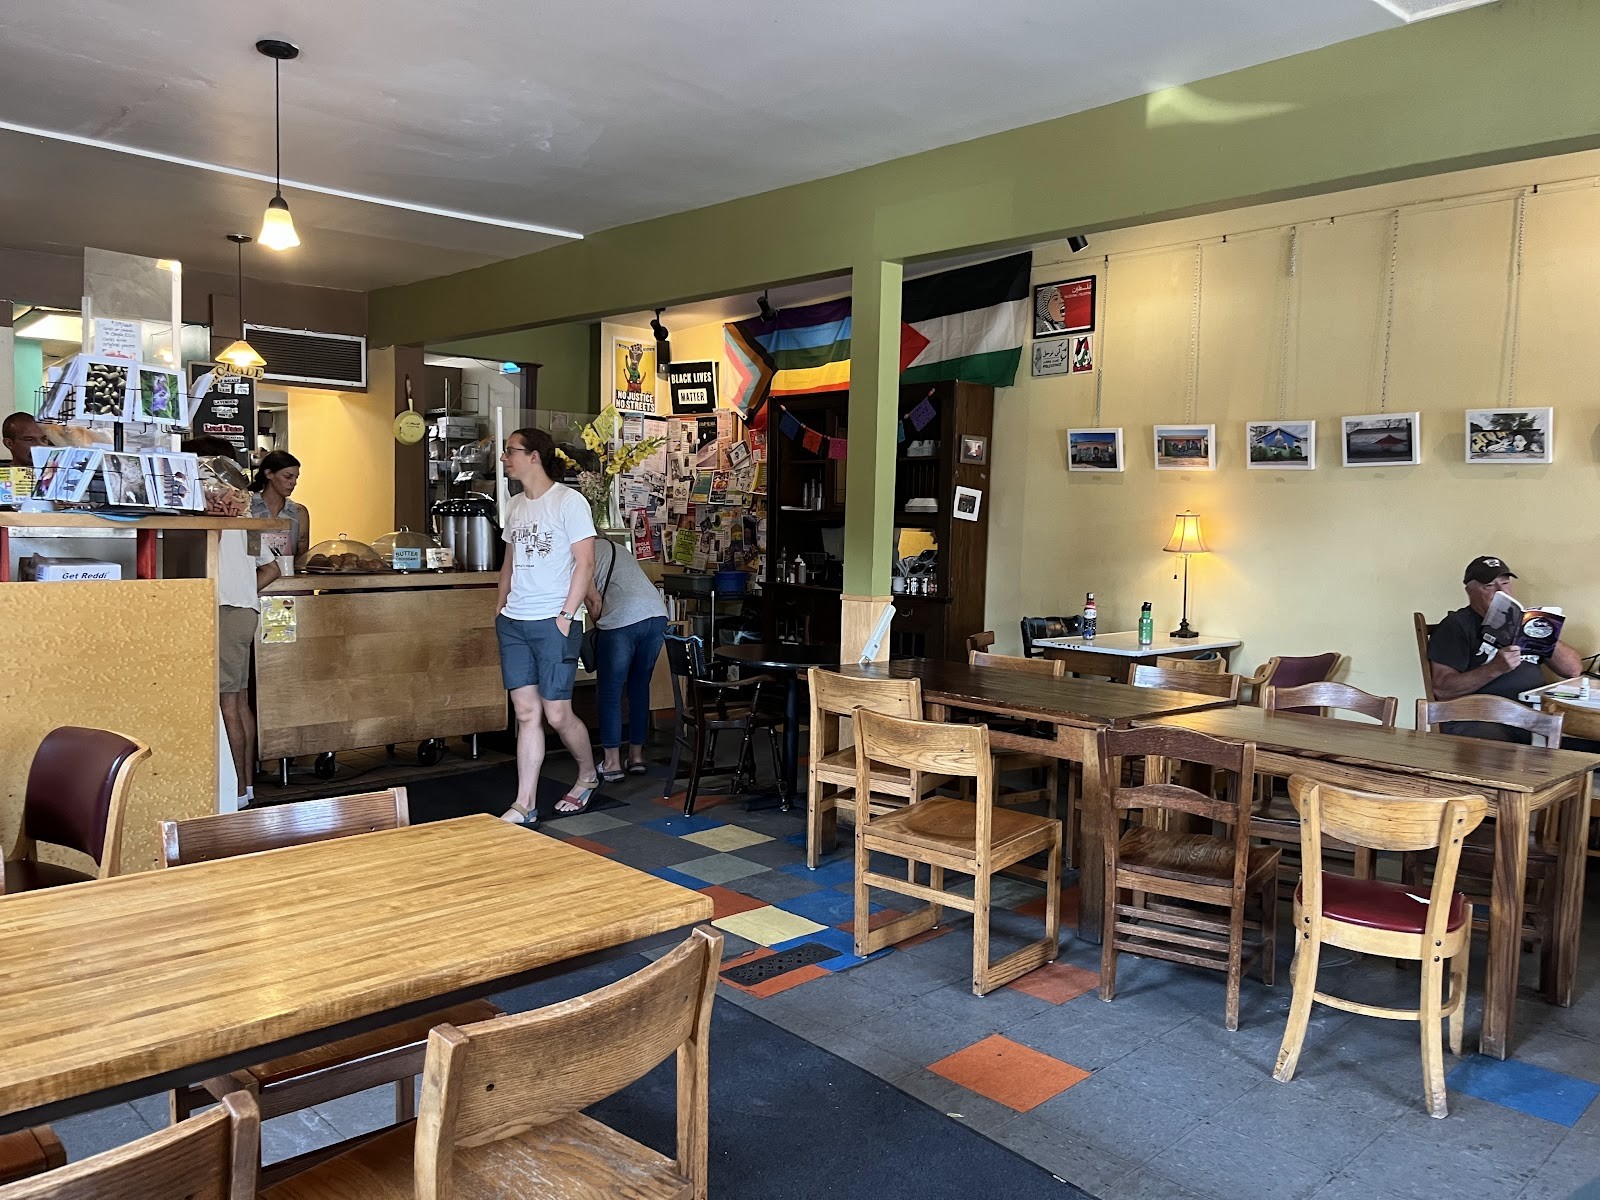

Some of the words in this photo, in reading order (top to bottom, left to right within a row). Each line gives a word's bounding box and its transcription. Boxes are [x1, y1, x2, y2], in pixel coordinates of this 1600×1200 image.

[671, 373, 692, 384] BLACK
[693, 371, 712, 383] LIVES
[617, 390, 627, 400] NO
[627, 391, 654, 404] JUSTICE
[680, 391, 705, 402] MATTER
[615, 400, 625, 409] NO
[625, 400, 655, 412] STREETS
